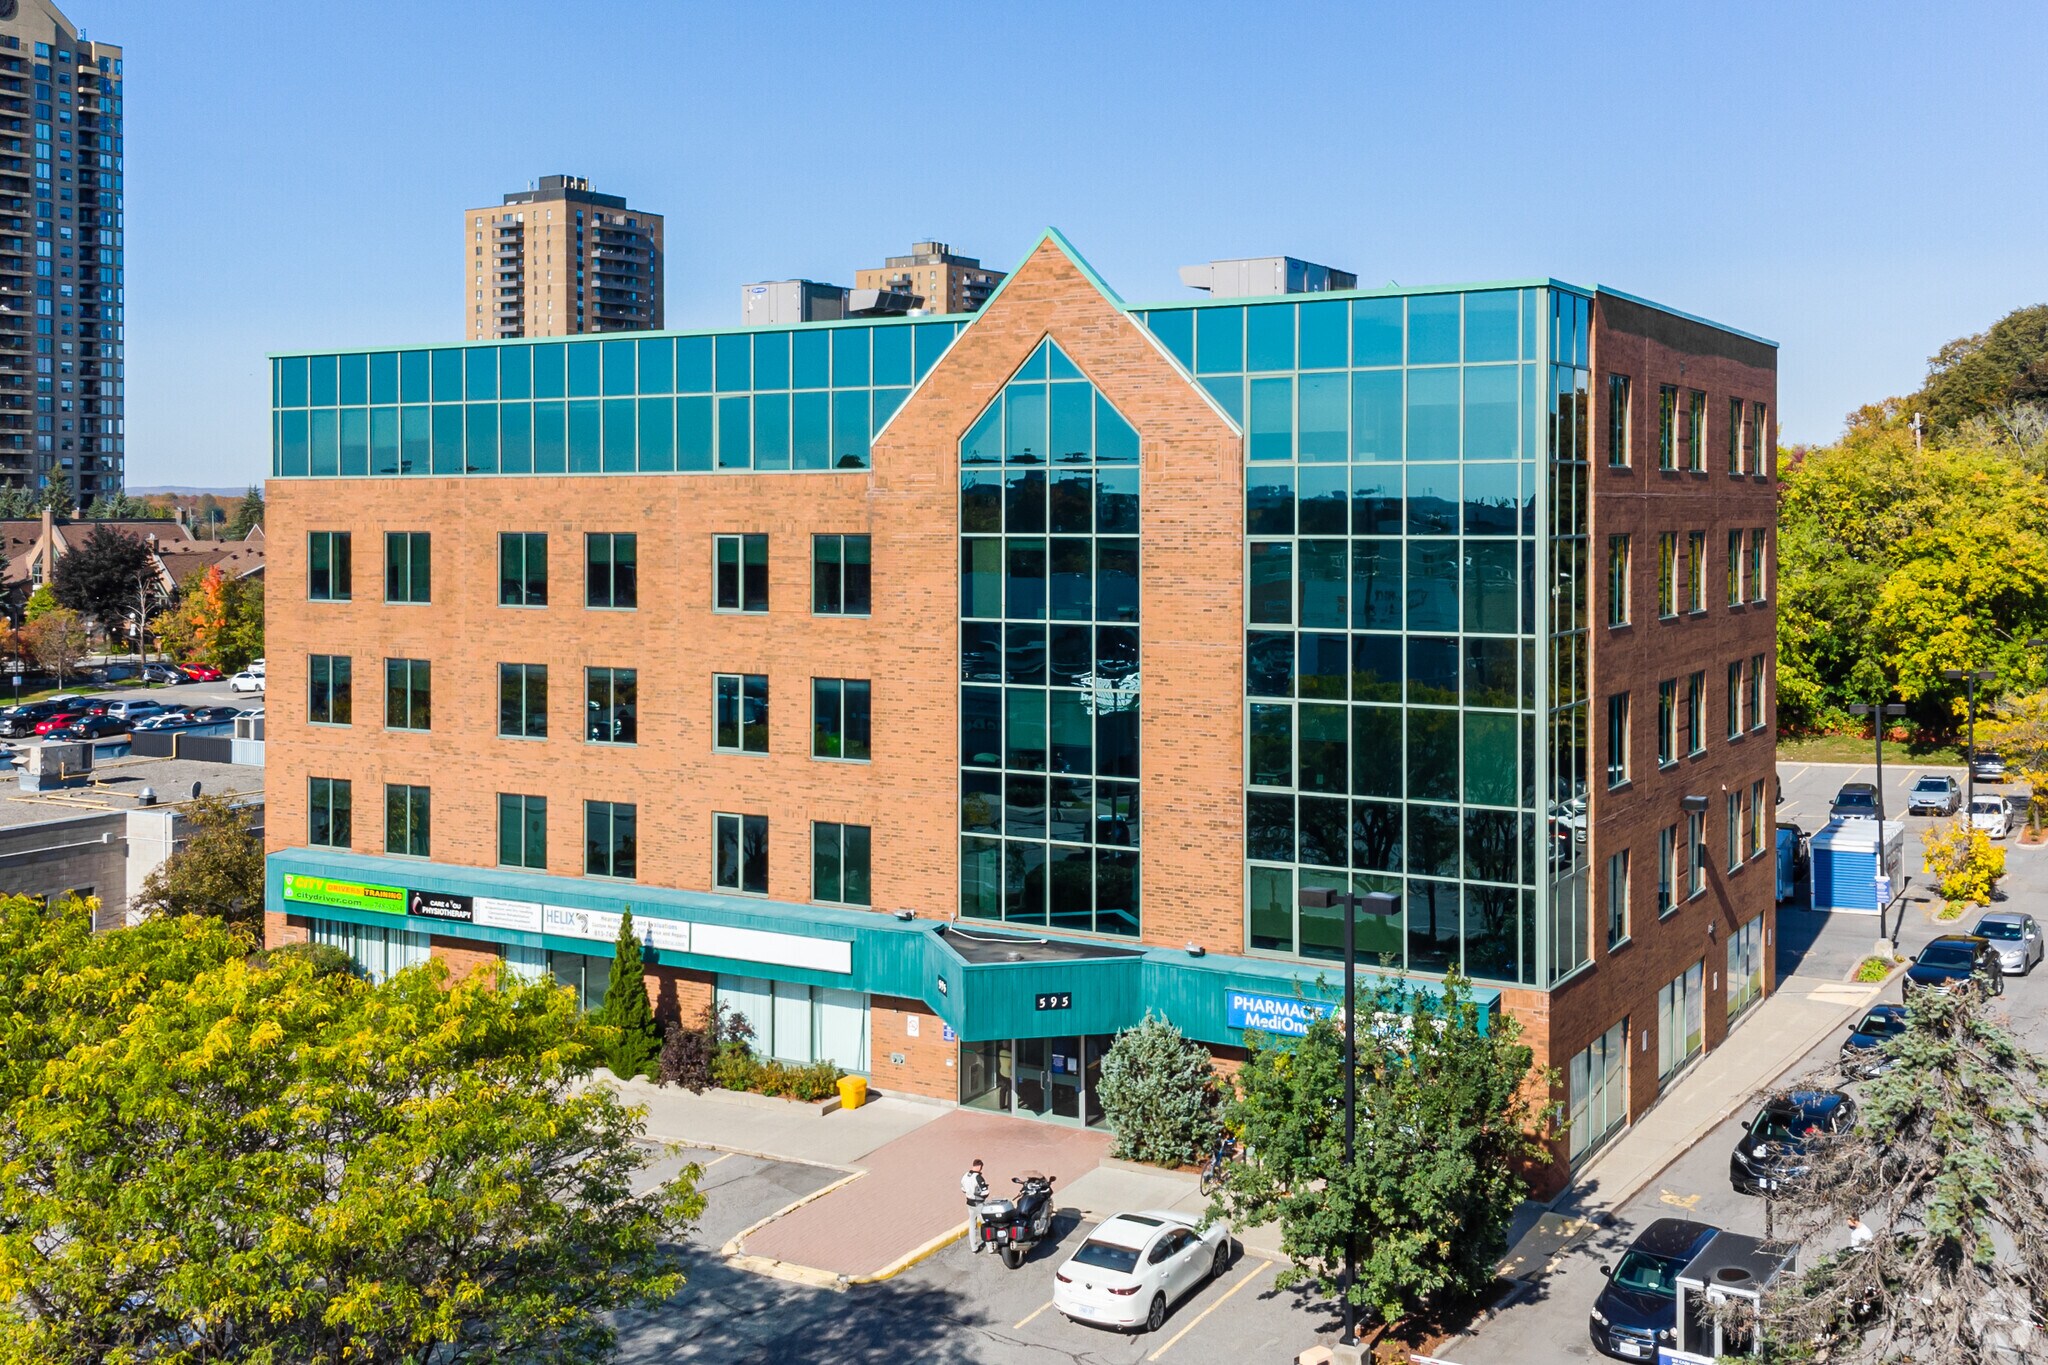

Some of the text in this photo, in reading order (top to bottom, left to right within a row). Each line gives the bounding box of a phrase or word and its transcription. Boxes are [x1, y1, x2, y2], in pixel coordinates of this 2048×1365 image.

[295, 877, 324, 890] CITY
[364, 889, 403, 900] TRAINING
[296, 891, 362, 906] citydriver.com
[430, 900, 445, 908] CARE
[422, 906, 472, 919] PHYSIOTHERAPY
[546, 909, 575, 926] HELIX
[1039, 996, 1069, 1009] 595
